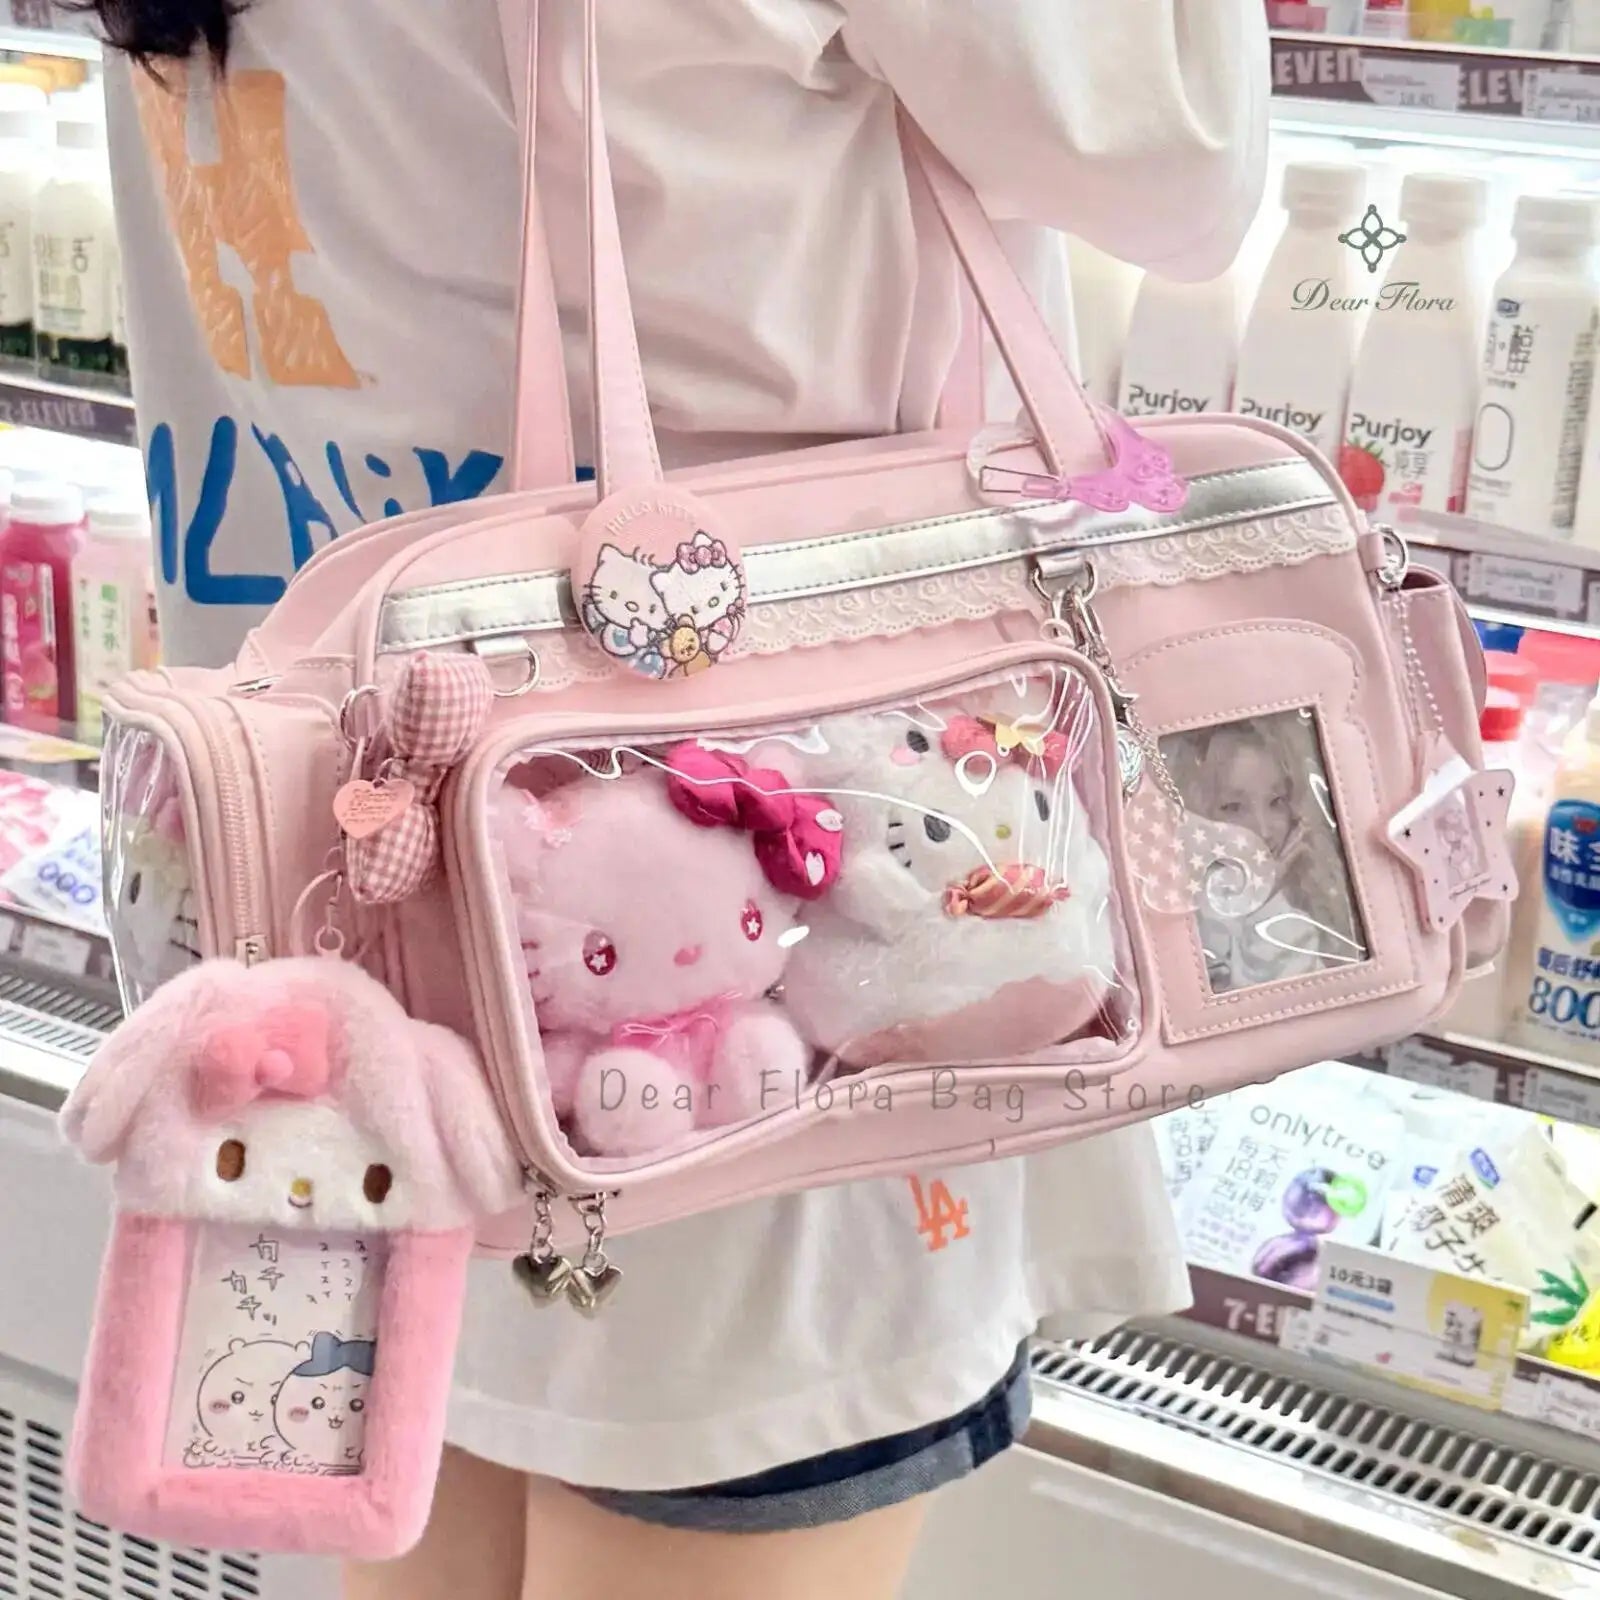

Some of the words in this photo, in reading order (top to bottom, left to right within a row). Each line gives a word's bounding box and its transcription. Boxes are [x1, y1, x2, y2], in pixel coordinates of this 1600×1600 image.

[1128, 383, 1211, 414] Purjoy
[1239, 398, 1323, 433] Purjoy
[1351, 413, 1432, 448] Purjoy
[1250, 1104, 1387, 1171] onlytree
[906, 1171, 971, 1251] LA
